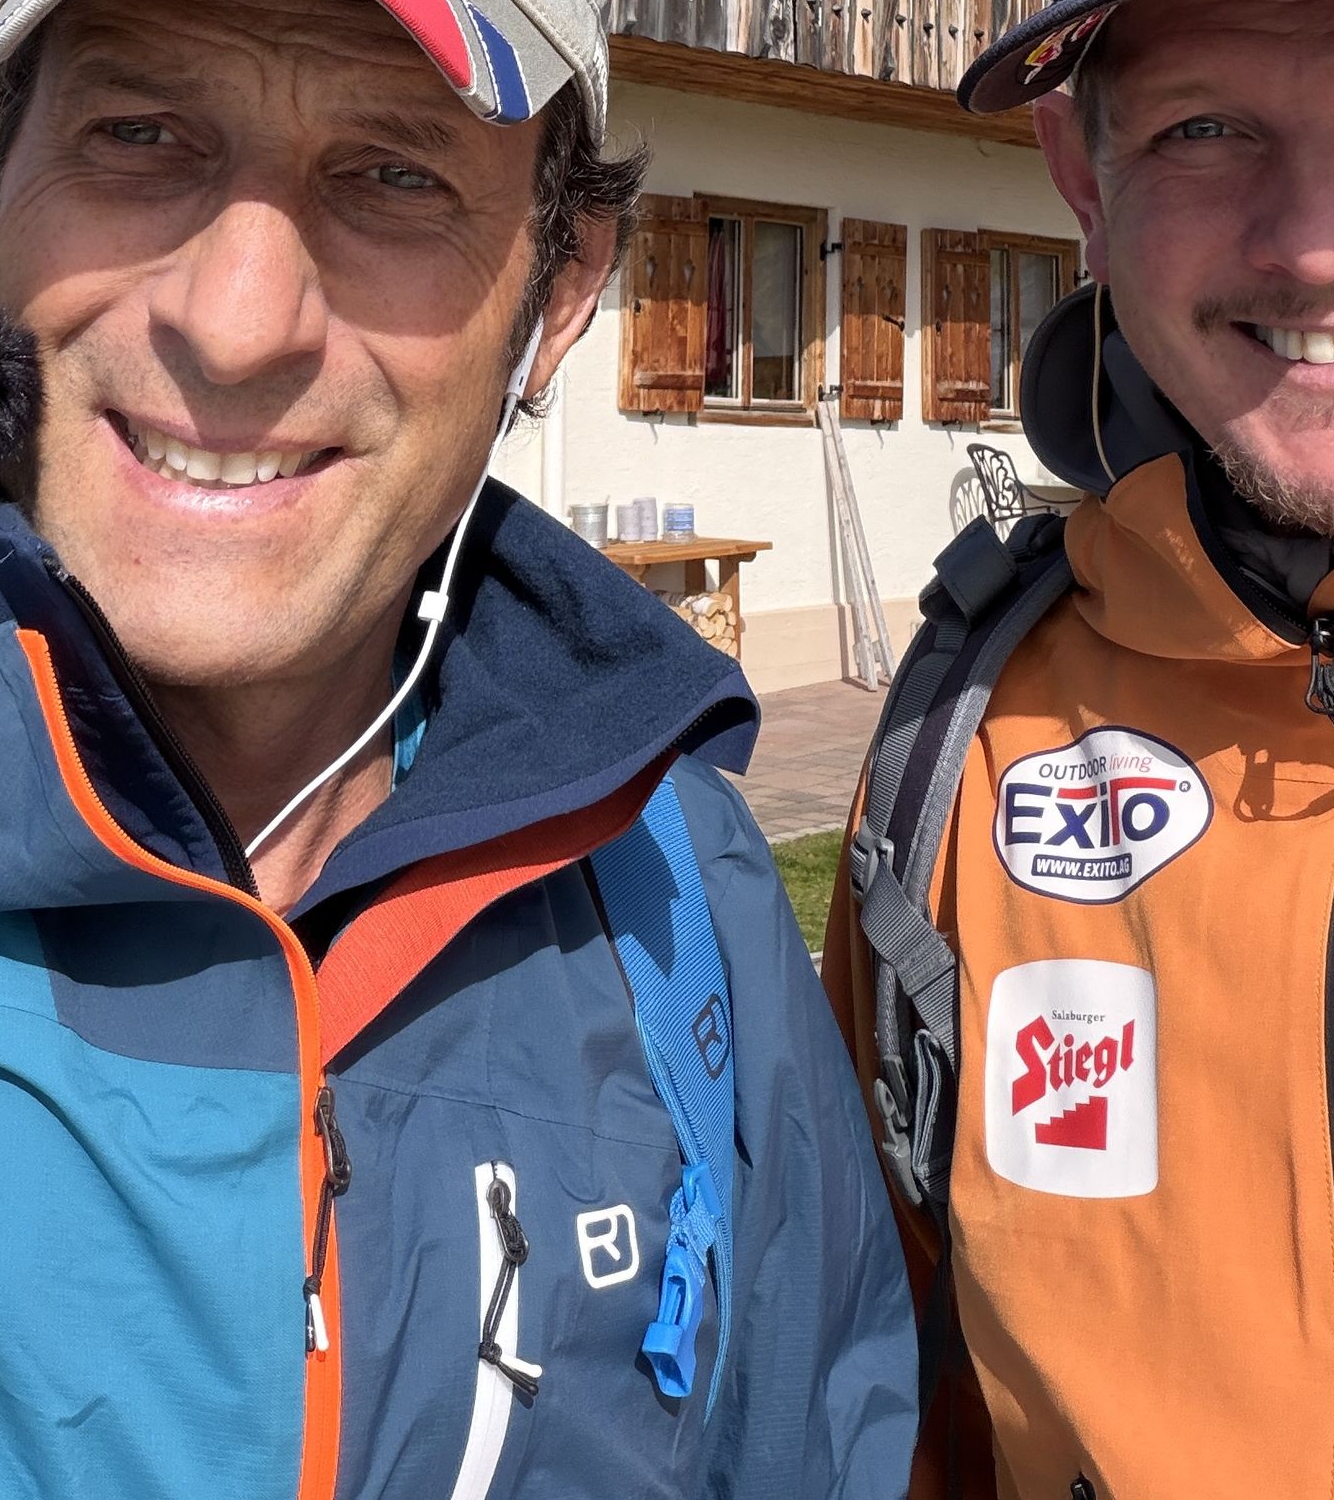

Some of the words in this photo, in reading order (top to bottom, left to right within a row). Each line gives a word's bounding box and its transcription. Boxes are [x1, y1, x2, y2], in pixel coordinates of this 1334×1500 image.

[1038, 756, 1107, 781] OUTDOOR
[1109, 753, 1154, 773] living
[1036, 856, 1131, 877] WWW.EXITO.AG
[1051, 1009, 1106, 1025] Salzburger
[1012, 1015, 1135, 1117] Stiegl
